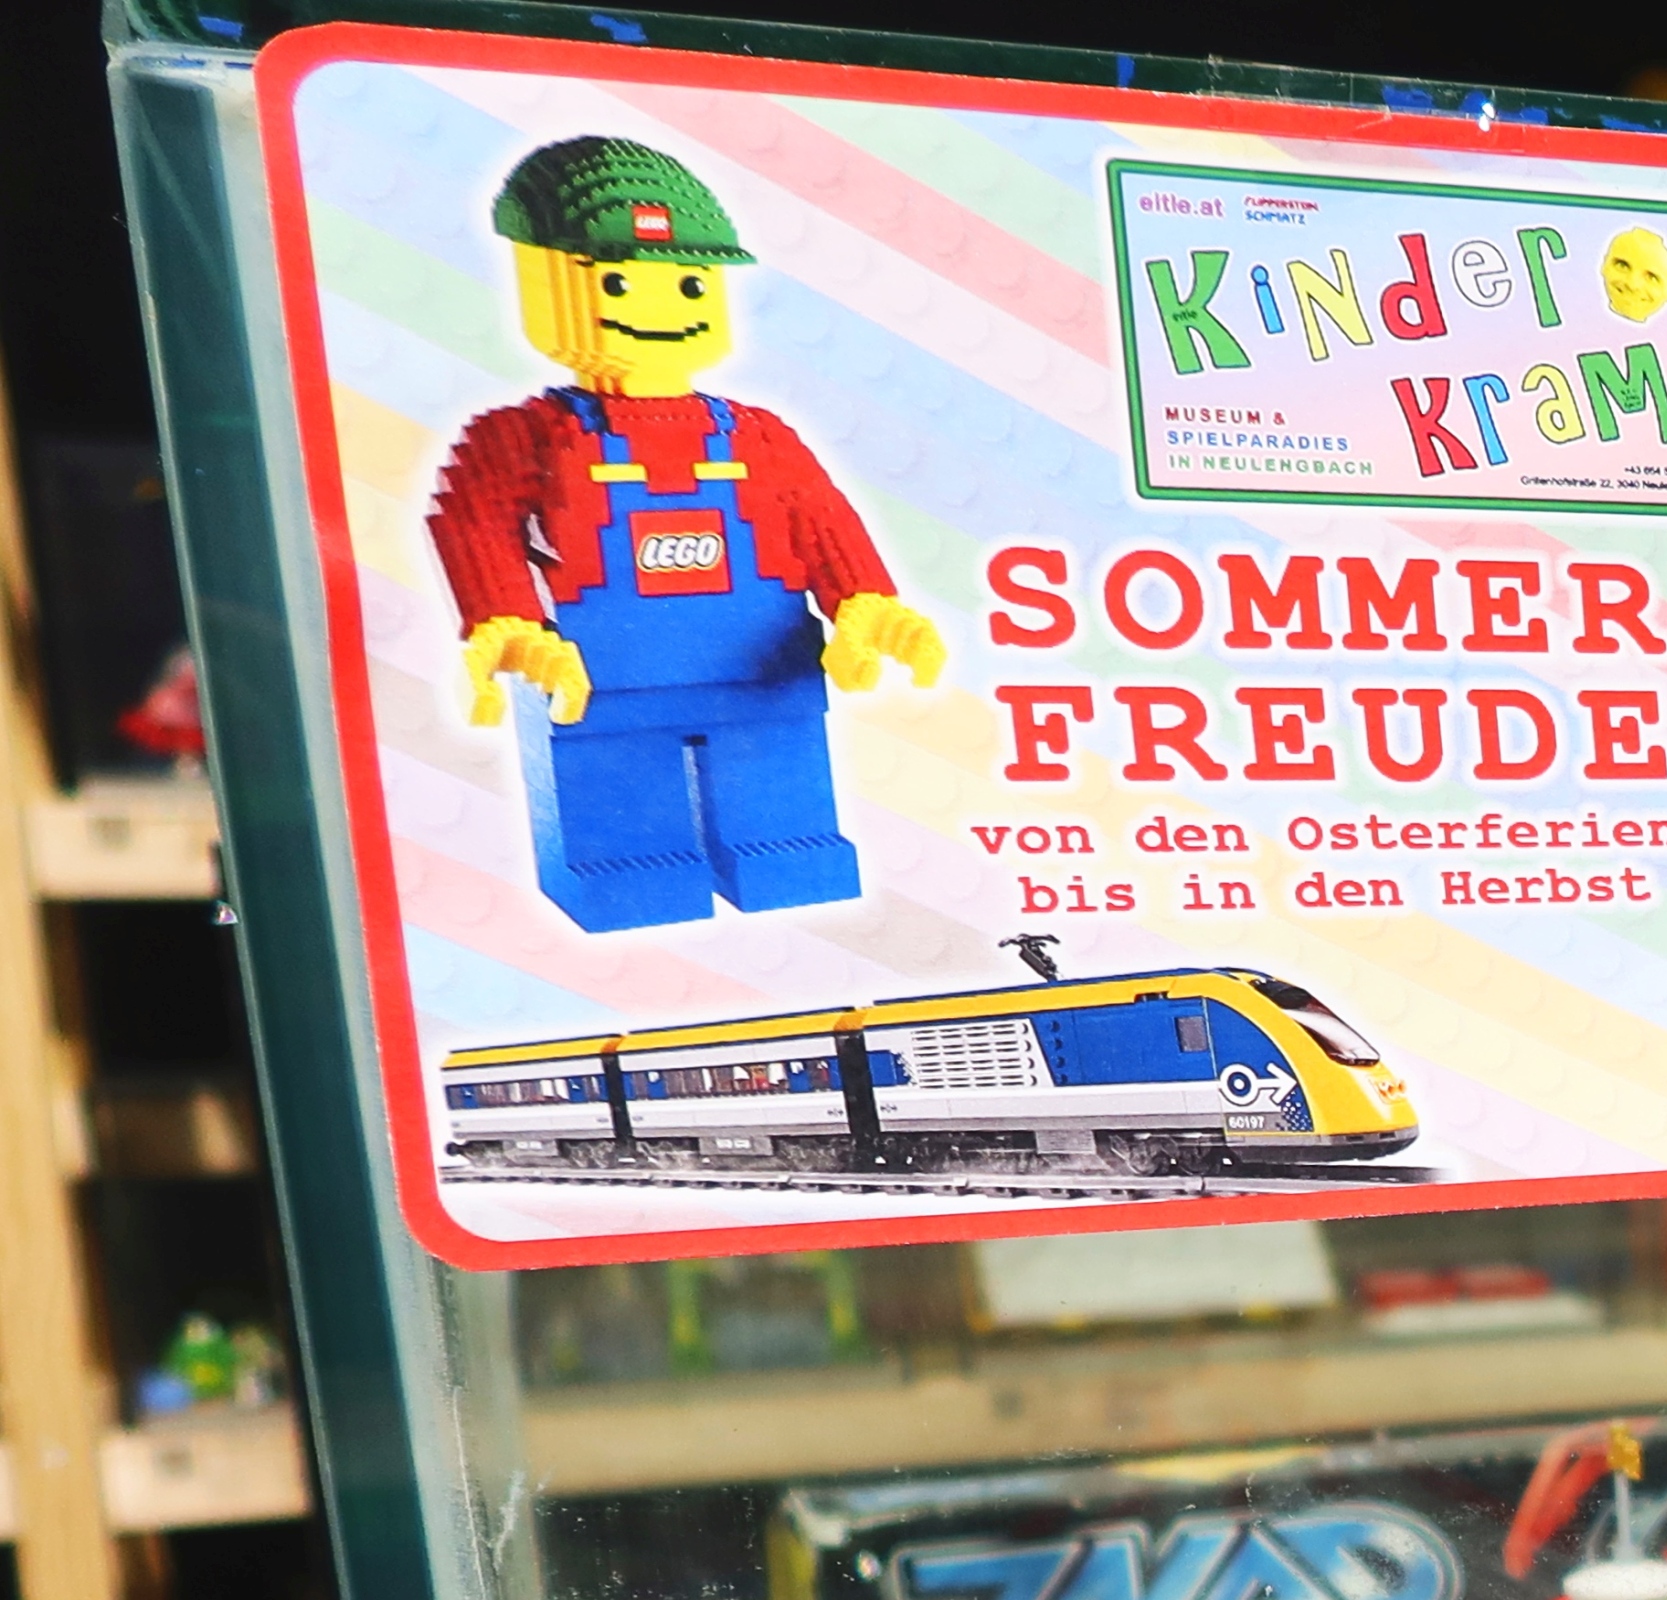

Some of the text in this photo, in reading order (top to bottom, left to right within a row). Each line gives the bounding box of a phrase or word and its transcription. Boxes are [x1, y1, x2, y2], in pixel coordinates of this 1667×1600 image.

[1165, 407, 1286, 426] MUSEUM &
[1167, 430, 1349, 451] SPIELPARADIES
[1169, 455, 1373, 475] IN NEULENGBACH
[640, 534, 722, 570] LEGO
[987, 546, 1667, 655] SOMMER
[970, 824, 1095, 854] von
[1135, 816, 1249, 852] den
[1018, 867, 1652, 913] bis in den Herbst
[1228, 1115, 1265, 1129] 60197
